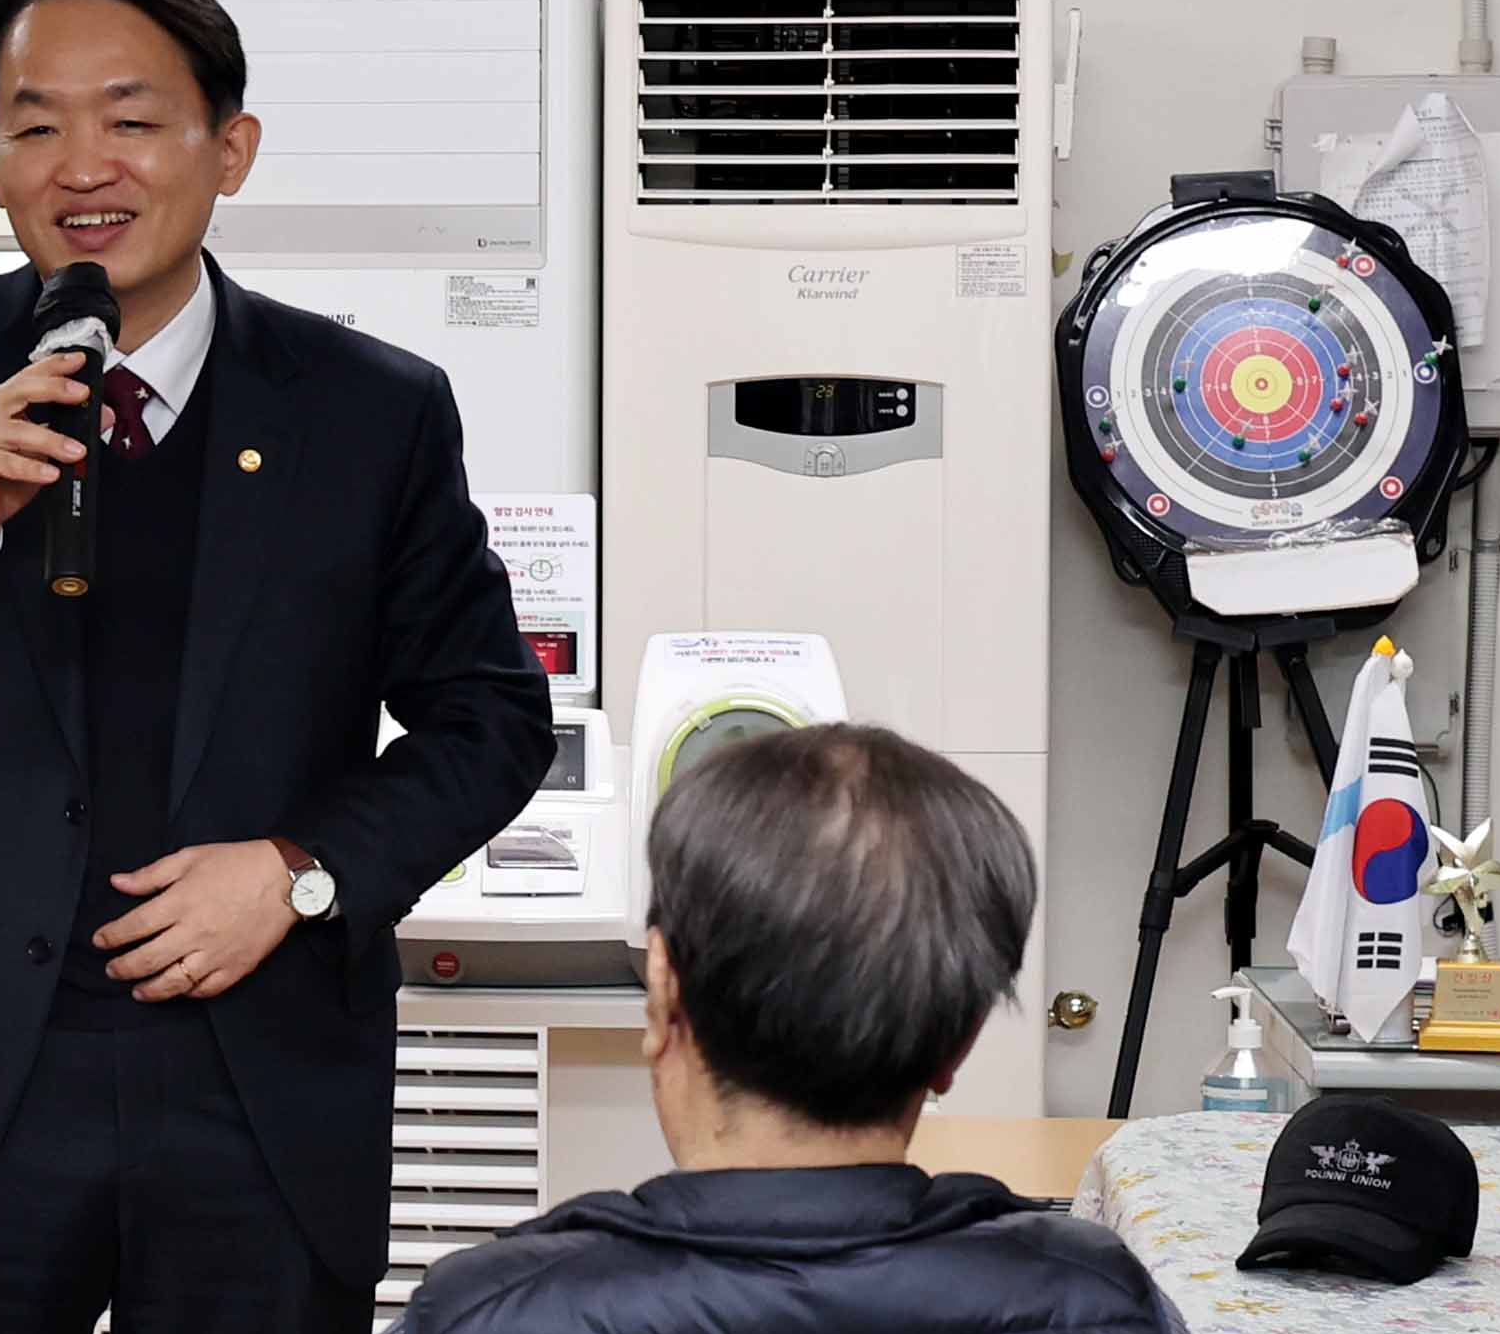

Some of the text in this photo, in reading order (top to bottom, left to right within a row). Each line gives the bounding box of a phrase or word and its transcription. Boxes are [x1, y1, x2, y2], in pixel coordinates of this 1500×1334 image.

[787, 264, 870, 284] Carrier
[796, 287, 860, 300] Klarwind
[815, 385, 835, 399] 23
[1351, 1174, 1391, 1189] UNION
